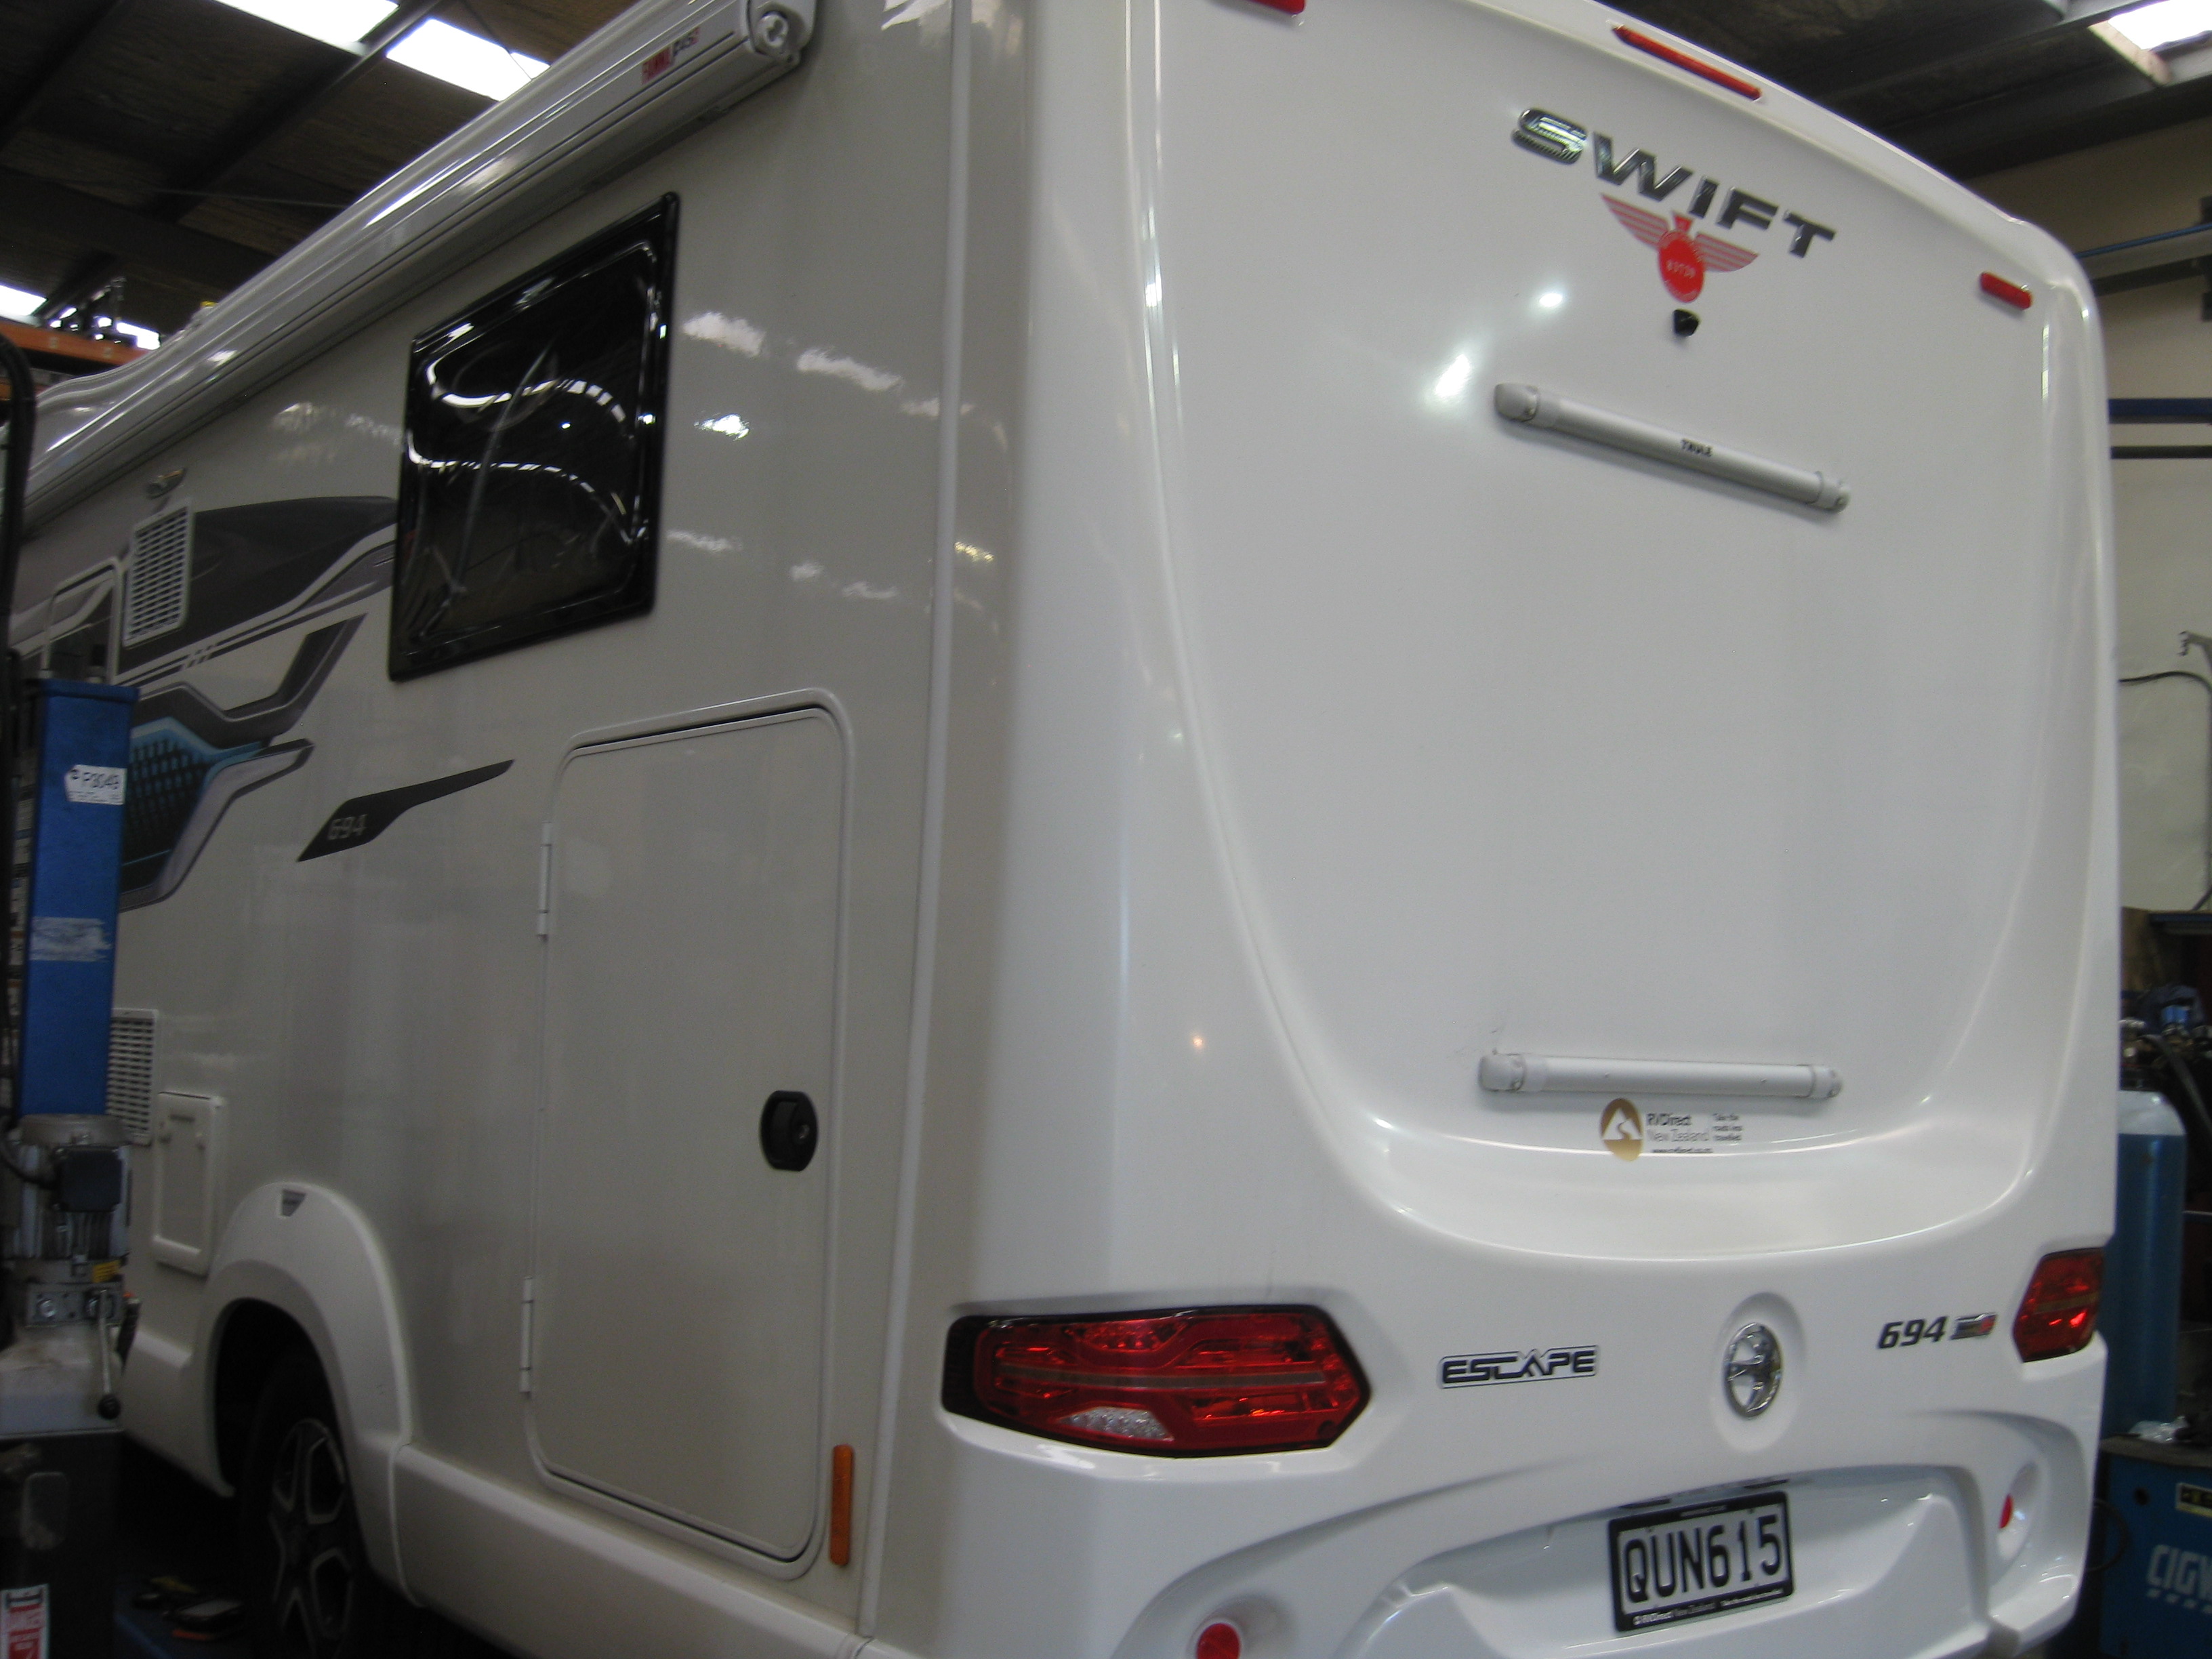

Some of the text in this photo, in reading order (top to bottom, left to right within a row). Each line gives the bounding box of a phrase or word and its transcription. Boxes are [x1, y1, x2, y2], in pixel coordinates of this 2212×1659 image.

[1511, 108, 1837, 258] SWIFT
[327, 814, 367, 841] 694
[1877, 1316, 1949, 1349] 694
[1441, 1349, 1596, 1384] ESCAPE
[1624, 1513, 1782, 1603] QUN615
